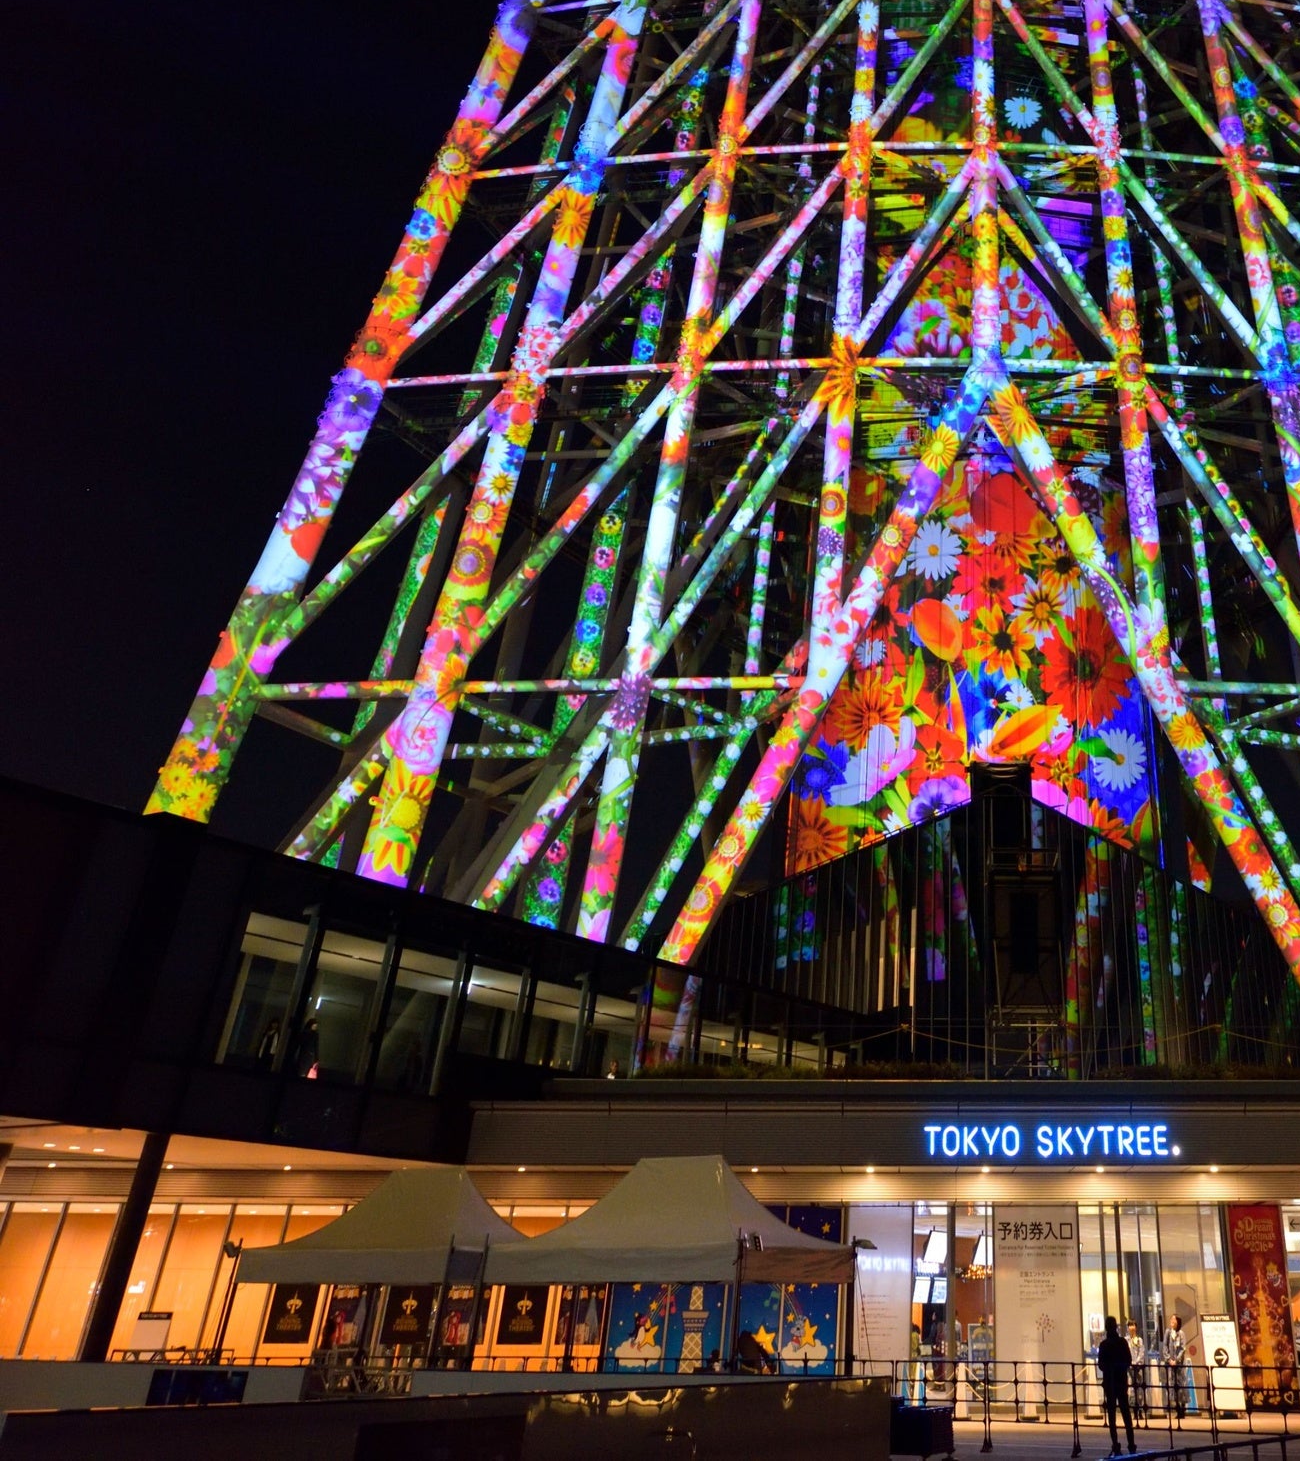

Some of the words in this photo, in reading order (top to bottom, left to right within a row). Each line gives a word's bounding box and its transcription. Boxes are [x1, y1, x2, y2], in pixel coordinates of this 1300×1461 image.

[924, 1125, 1020, 1157] TOKYO
[997, 1221, 1073, 1241] 予約券入口
[1250, 1241, 1268, 1252] 2016
